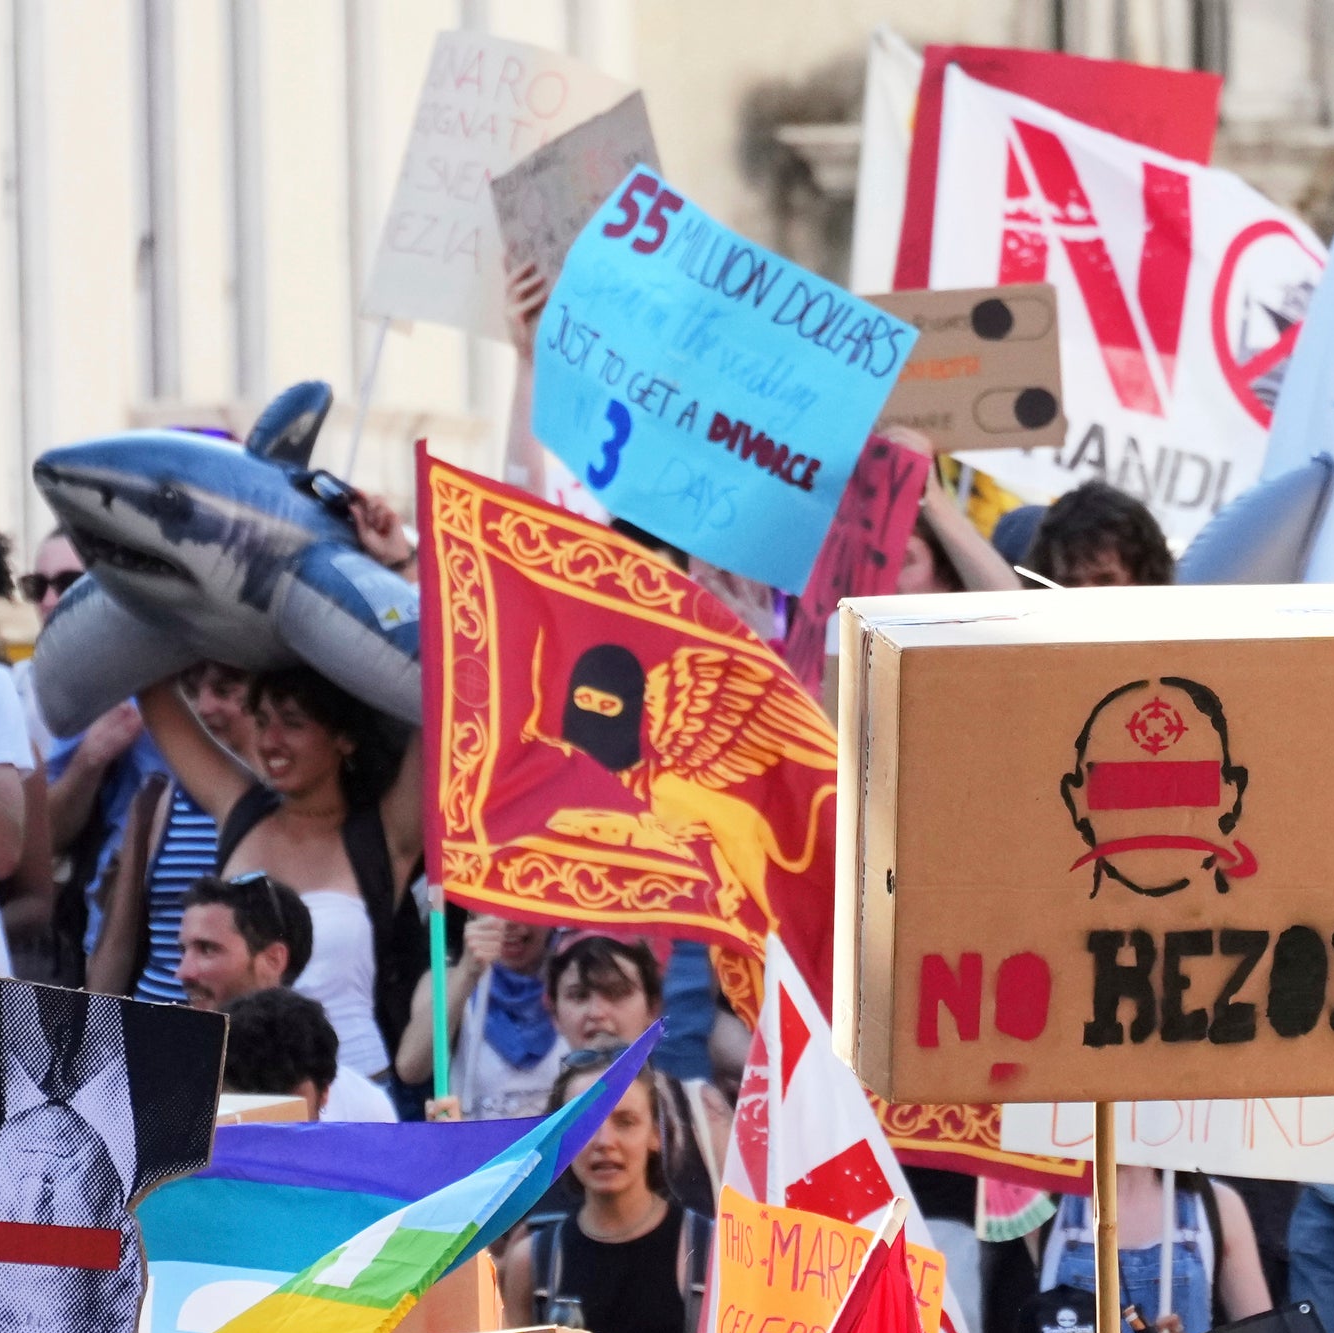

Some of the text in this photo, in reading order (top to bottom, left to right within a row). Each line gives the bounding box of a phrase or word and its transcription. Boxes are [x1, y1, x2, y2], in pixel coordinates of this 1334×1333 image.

[602, 172, 685, 255] 55
[771, 280, 906, 379] DOLLARS
[548, 304, 823, 494] JUST TO GET A DIVORCE
[586, 398, 633, 492] 3
[916, 952, 1054, 1049] NO
[721, 1212, 755, 1270] THIS
